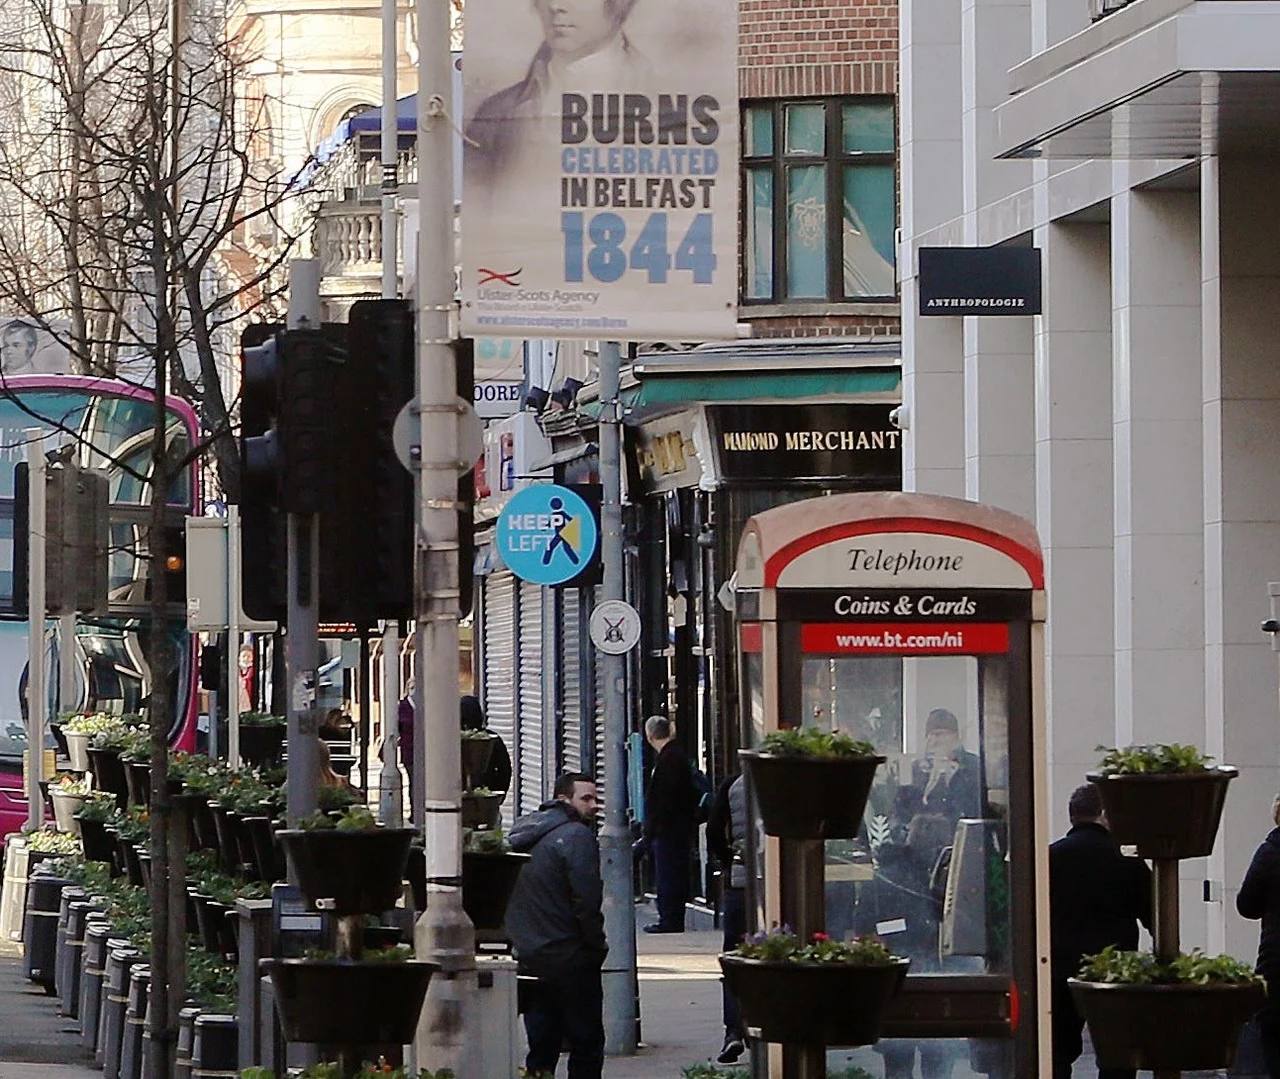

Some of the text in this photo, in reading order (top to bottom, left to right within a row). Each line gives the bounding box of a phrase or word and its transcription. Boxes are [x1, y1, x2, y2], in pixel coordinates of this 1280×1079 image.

[561, 93, 720, 145] BURNS
[561, 148, 719, 175] CELEBRATED
[561, 178, 715, 208] IN BELFAST
[561, 211, 717, 284] 1844
[477, 290, 600, 303] Ulster-Scots Agency
[927, 298, 1025, 307] ANTHROPOLOGIE
[508, 514, 564, 530] KEEP
[509, 535, 553, 552] LEFT
[847, 549, 963, 575] Telephone
[834, 595, 977, 616] Coins & Cards
[836, 632, 963, 648] www.bt.com/ni
